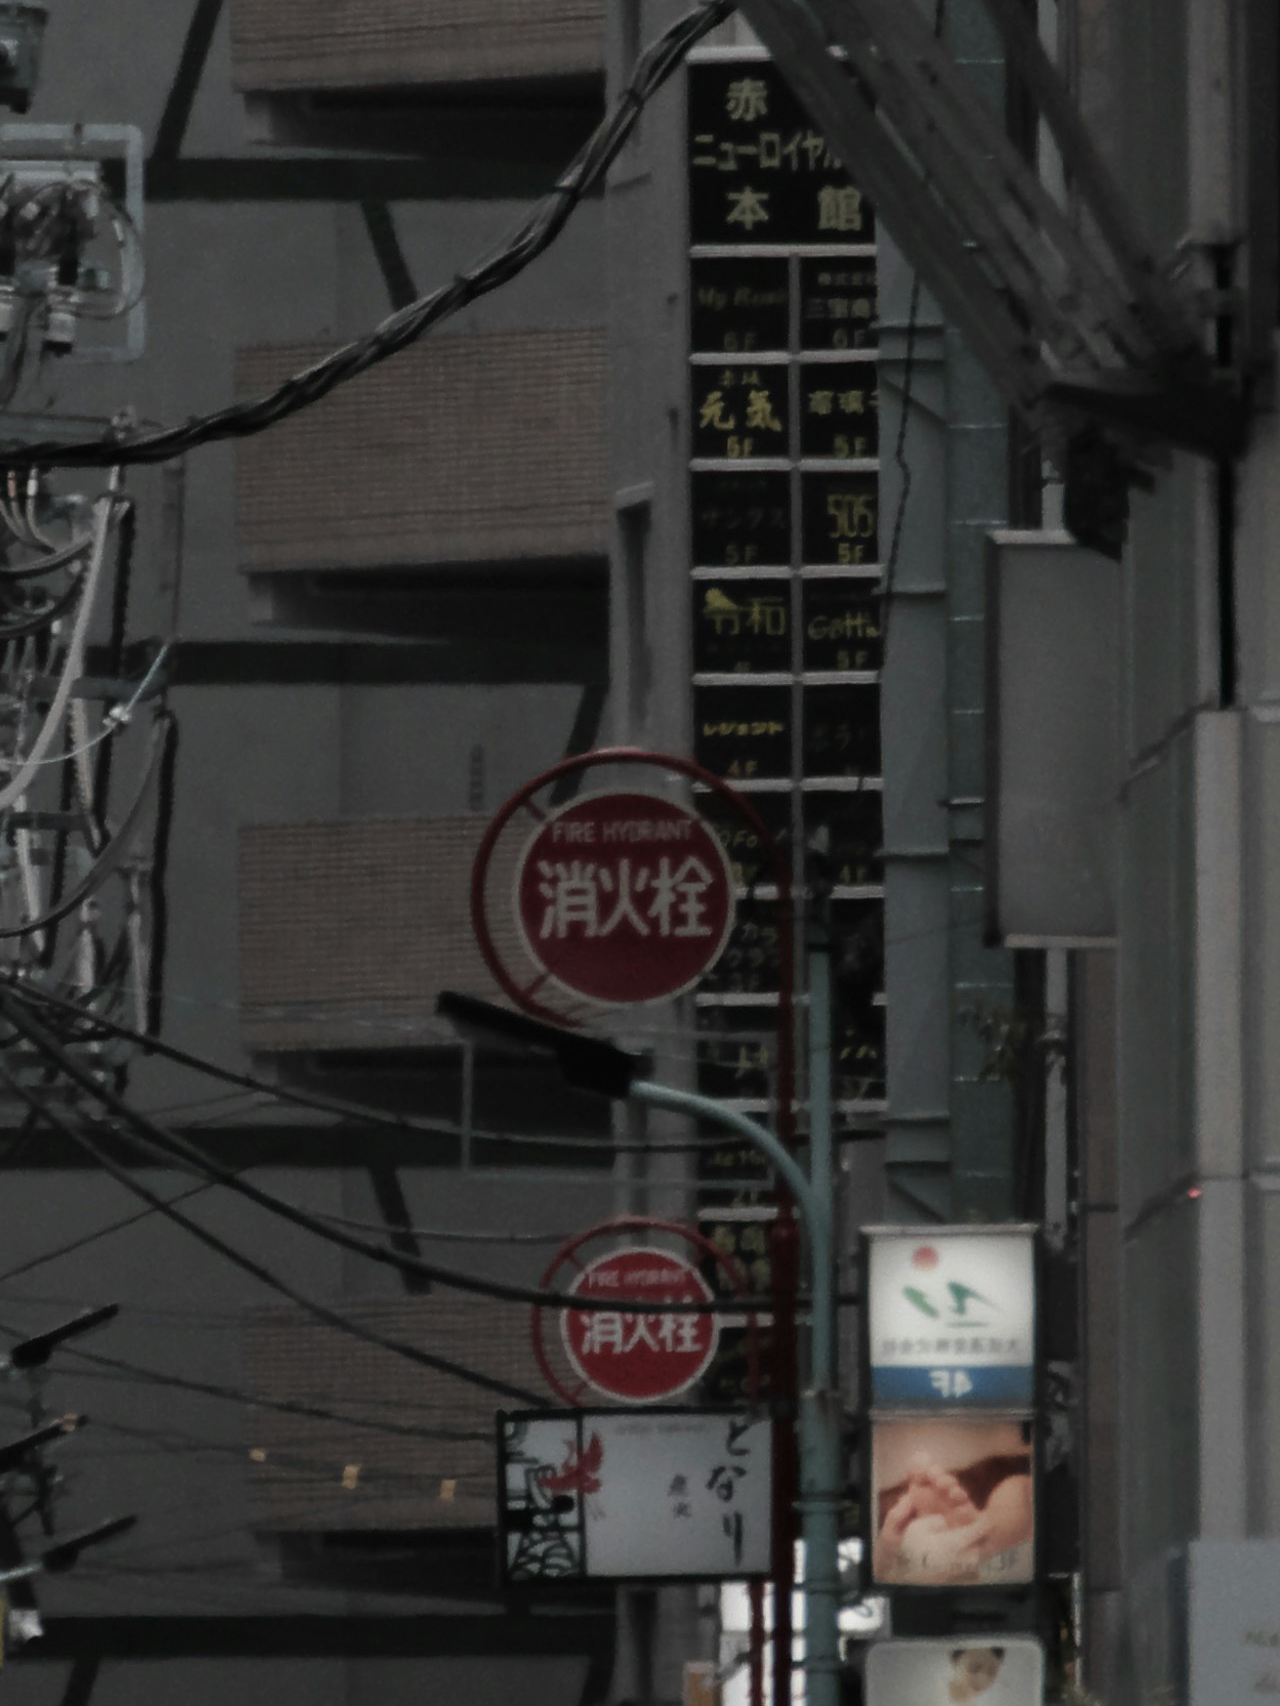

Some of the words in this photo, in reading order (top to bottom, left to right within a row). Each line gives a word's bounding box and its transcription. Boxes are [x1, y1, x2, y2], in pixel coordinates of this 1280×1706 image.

[551, 821, 596, 843] FIRE
[601, 818, 693, 843] HYDRANT
[537, 856, 715, 939] 消火栓
